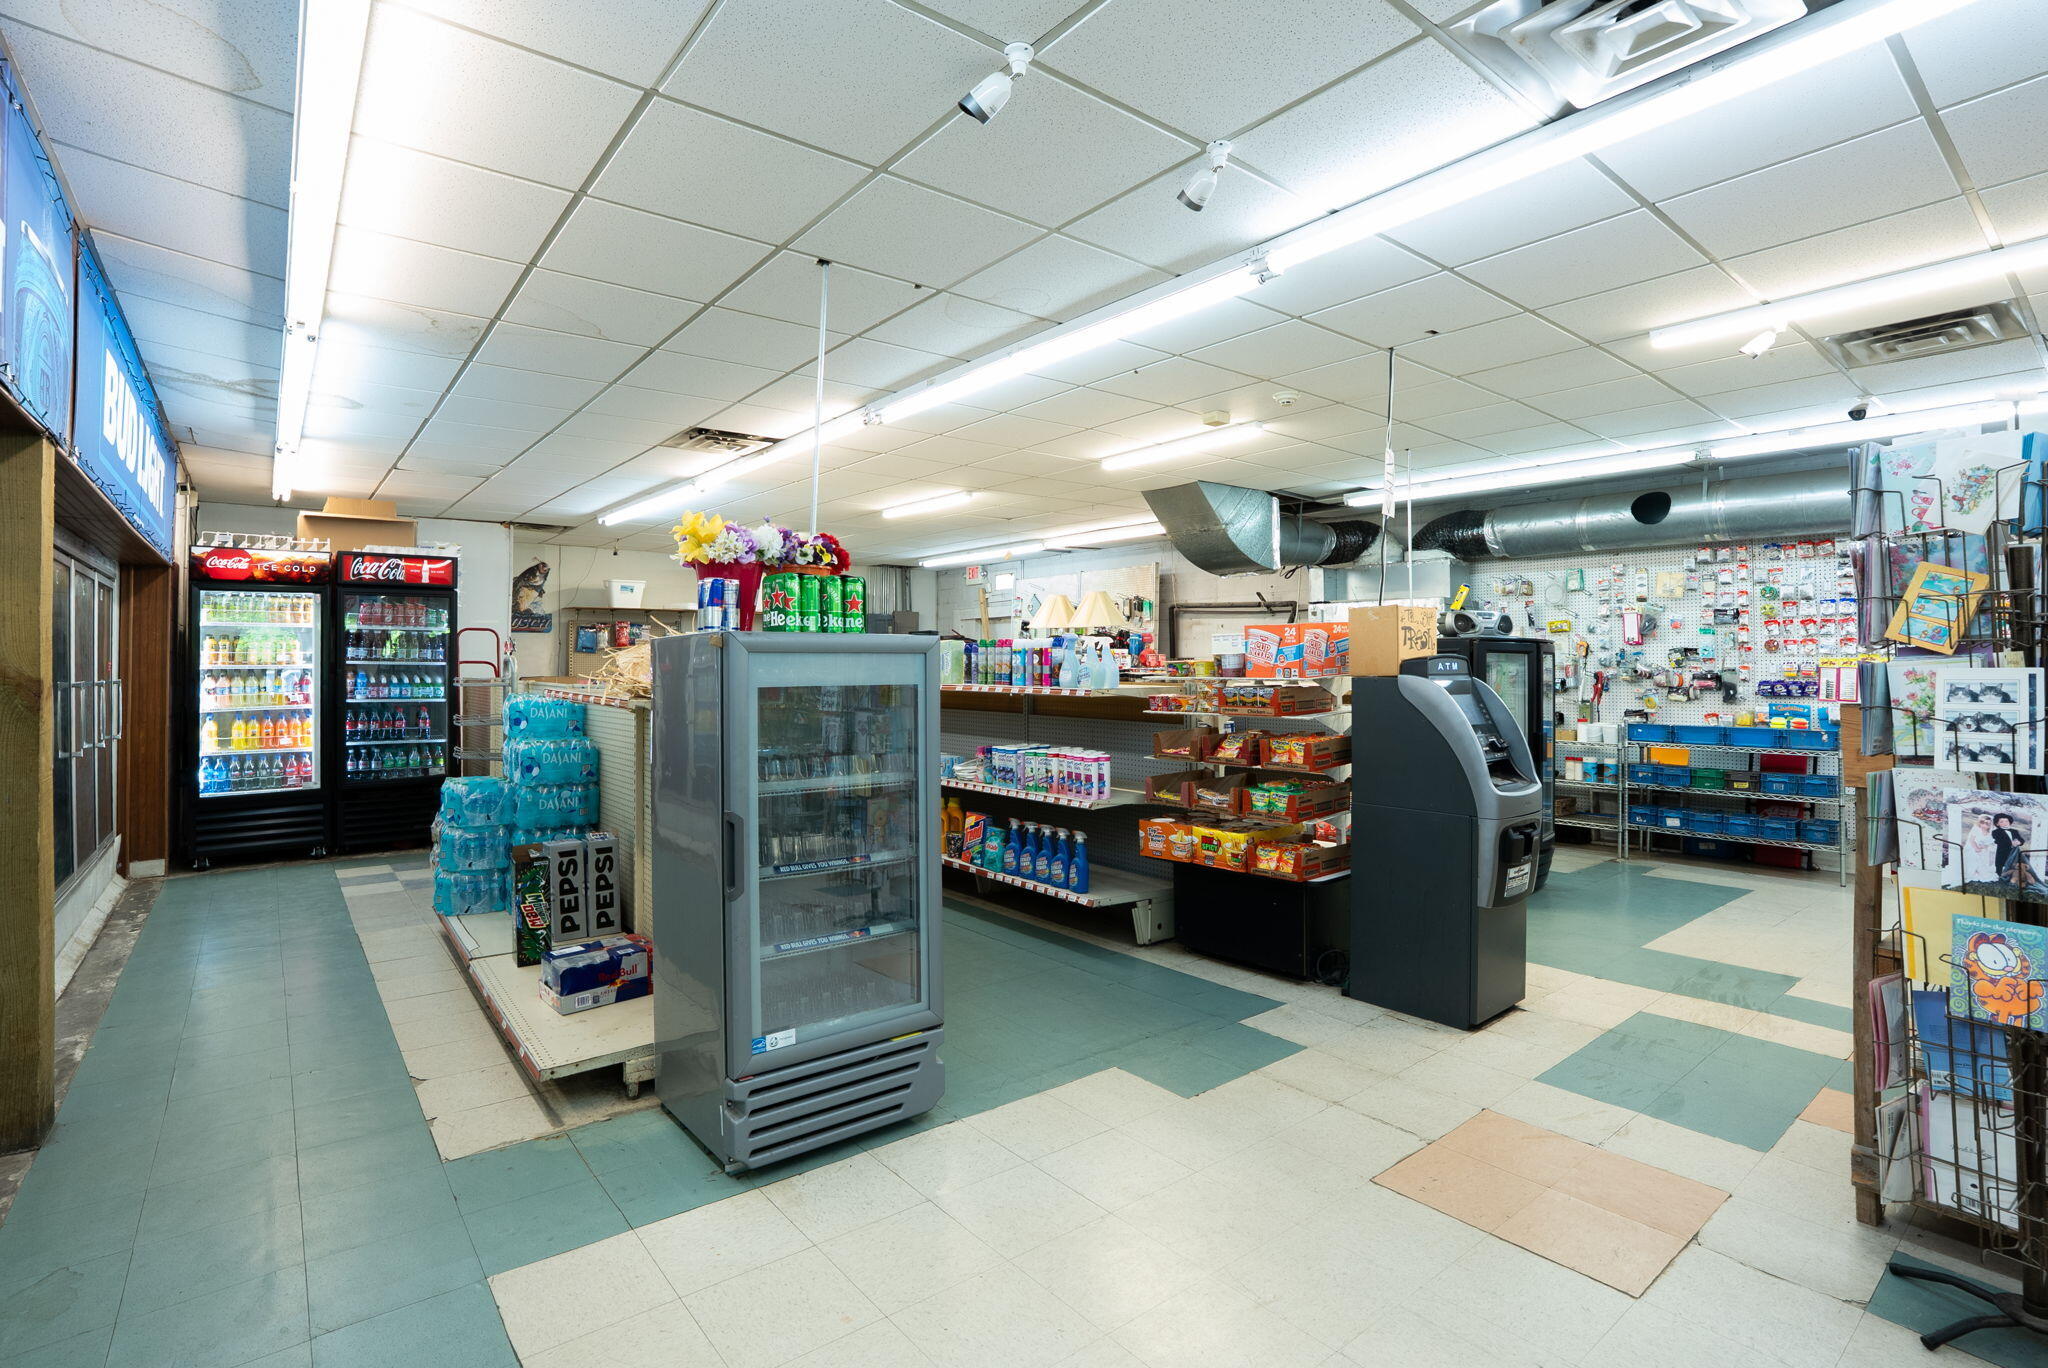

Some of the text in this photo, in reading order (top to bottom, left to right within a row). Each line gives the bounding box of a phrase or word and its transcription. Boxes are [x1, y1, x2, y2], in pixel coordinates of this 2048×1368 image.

[103, 348, 165, 518] BUD LIGHT
[206, 556, 251, 569] Coca-Cola
[284, 565, 317, 573] COLD
[350, 557, 406, 580] Coca-Cola
[1285, 627, 1296, 636] 24
[1333, 625, 1341, 633] 24
[1437, 662, 1458, 671] ATM
[530, 706, 567, 720] DASANI
[542, 750, 581, 766] DASANI
[539, 795, 578, 810] DASANI
[558, 849, 580, 933] PEPSI
[595, 846, 614, 929] PEPSI
[620, 964, 638, 976] Bull
